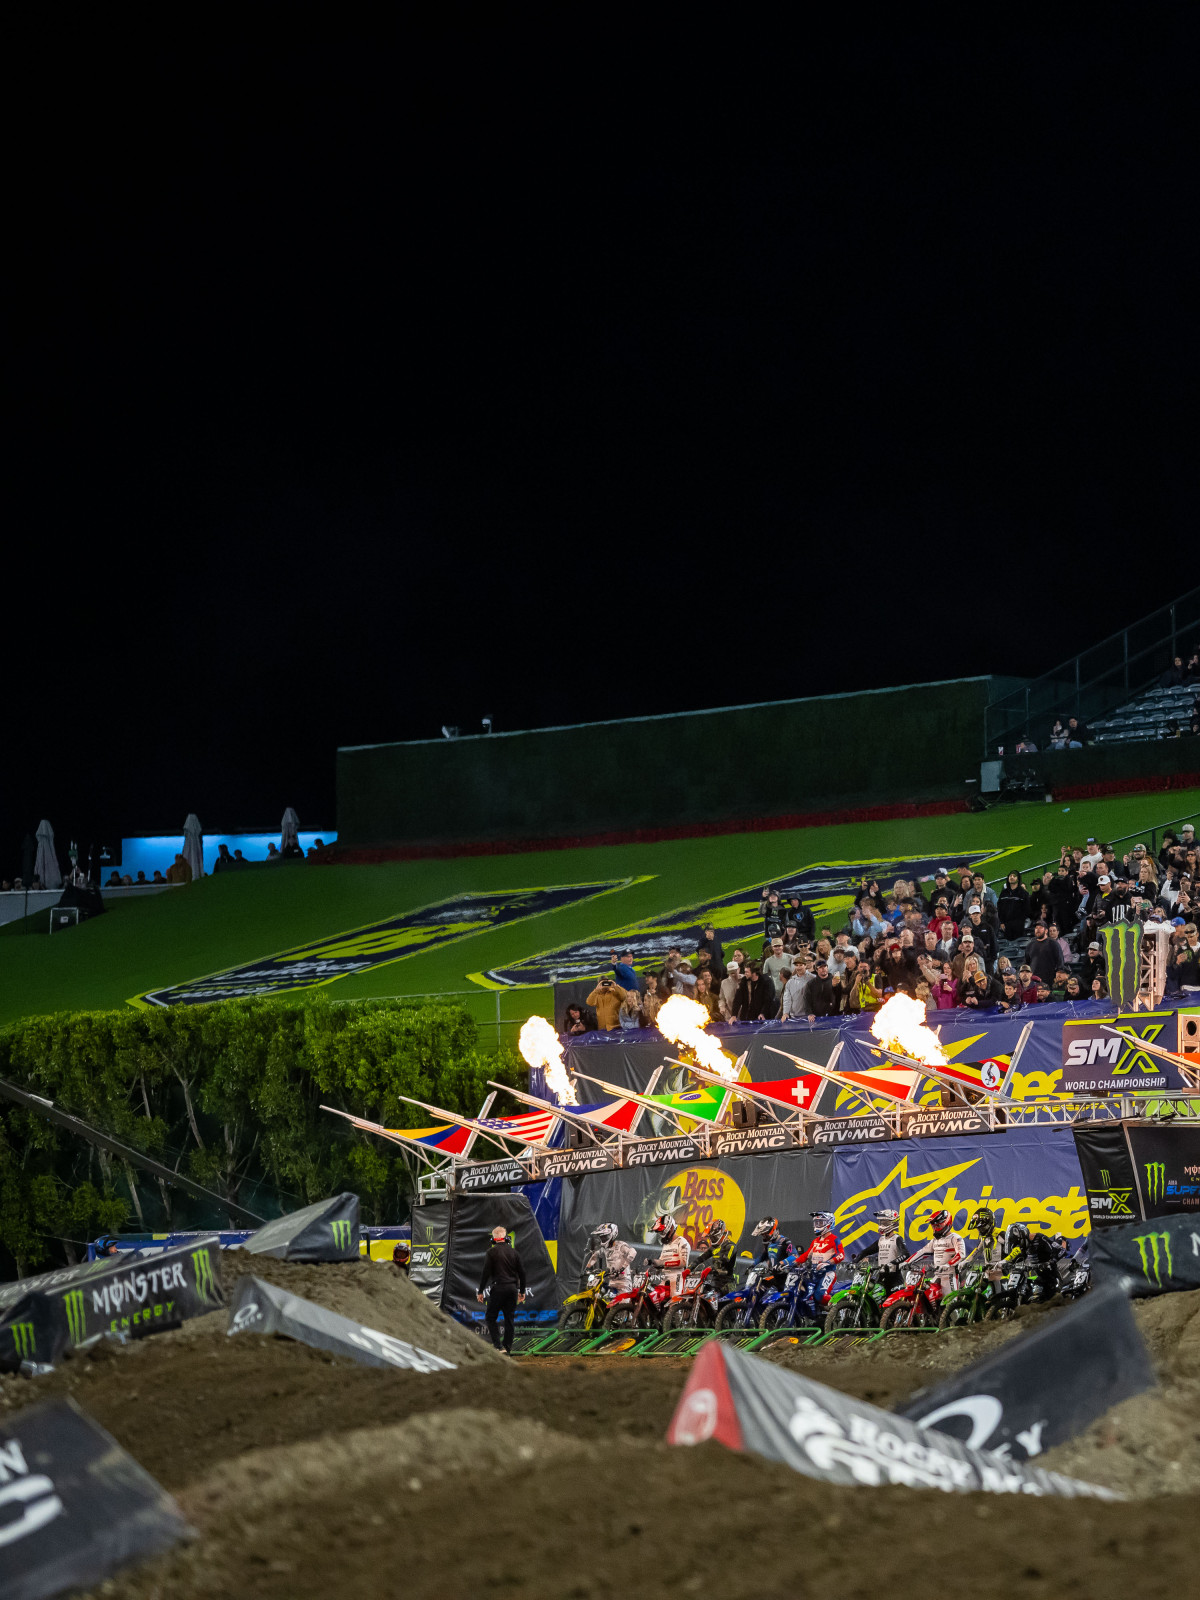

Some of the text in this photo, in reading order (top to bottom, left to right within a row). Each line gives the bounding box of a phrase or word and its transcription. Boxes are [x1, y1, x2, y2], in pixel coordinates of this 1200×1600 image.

[1064, 1024, 1165, 1074] SMX
[1065, 1077, 1166, 1090] WORLD CHAMPIONSHIP
[917, 1112, 939, 1121] ROCKY
[726, 1127, 785, 1141] ROCKY MOUNTAIN
[824, 1121, 846, 1130] ROCKY
[552, 1149, 607, 1164] ROCKY MOUNTAIN
[637, 1143, 658, 1153] ROCKY
[470, 1165, 490, 1176] ROCKY
[682, 1172, 725, 1201] Bass
[1090, 1193, 1132, 1213] SMX
[681, 1200, 713, 1228] Pro
[411, 1247, 444, 1267] SMX
[92, 1262, 188, 1315] MONSTER
[110, 1301, 175, 1333] ENERGY
